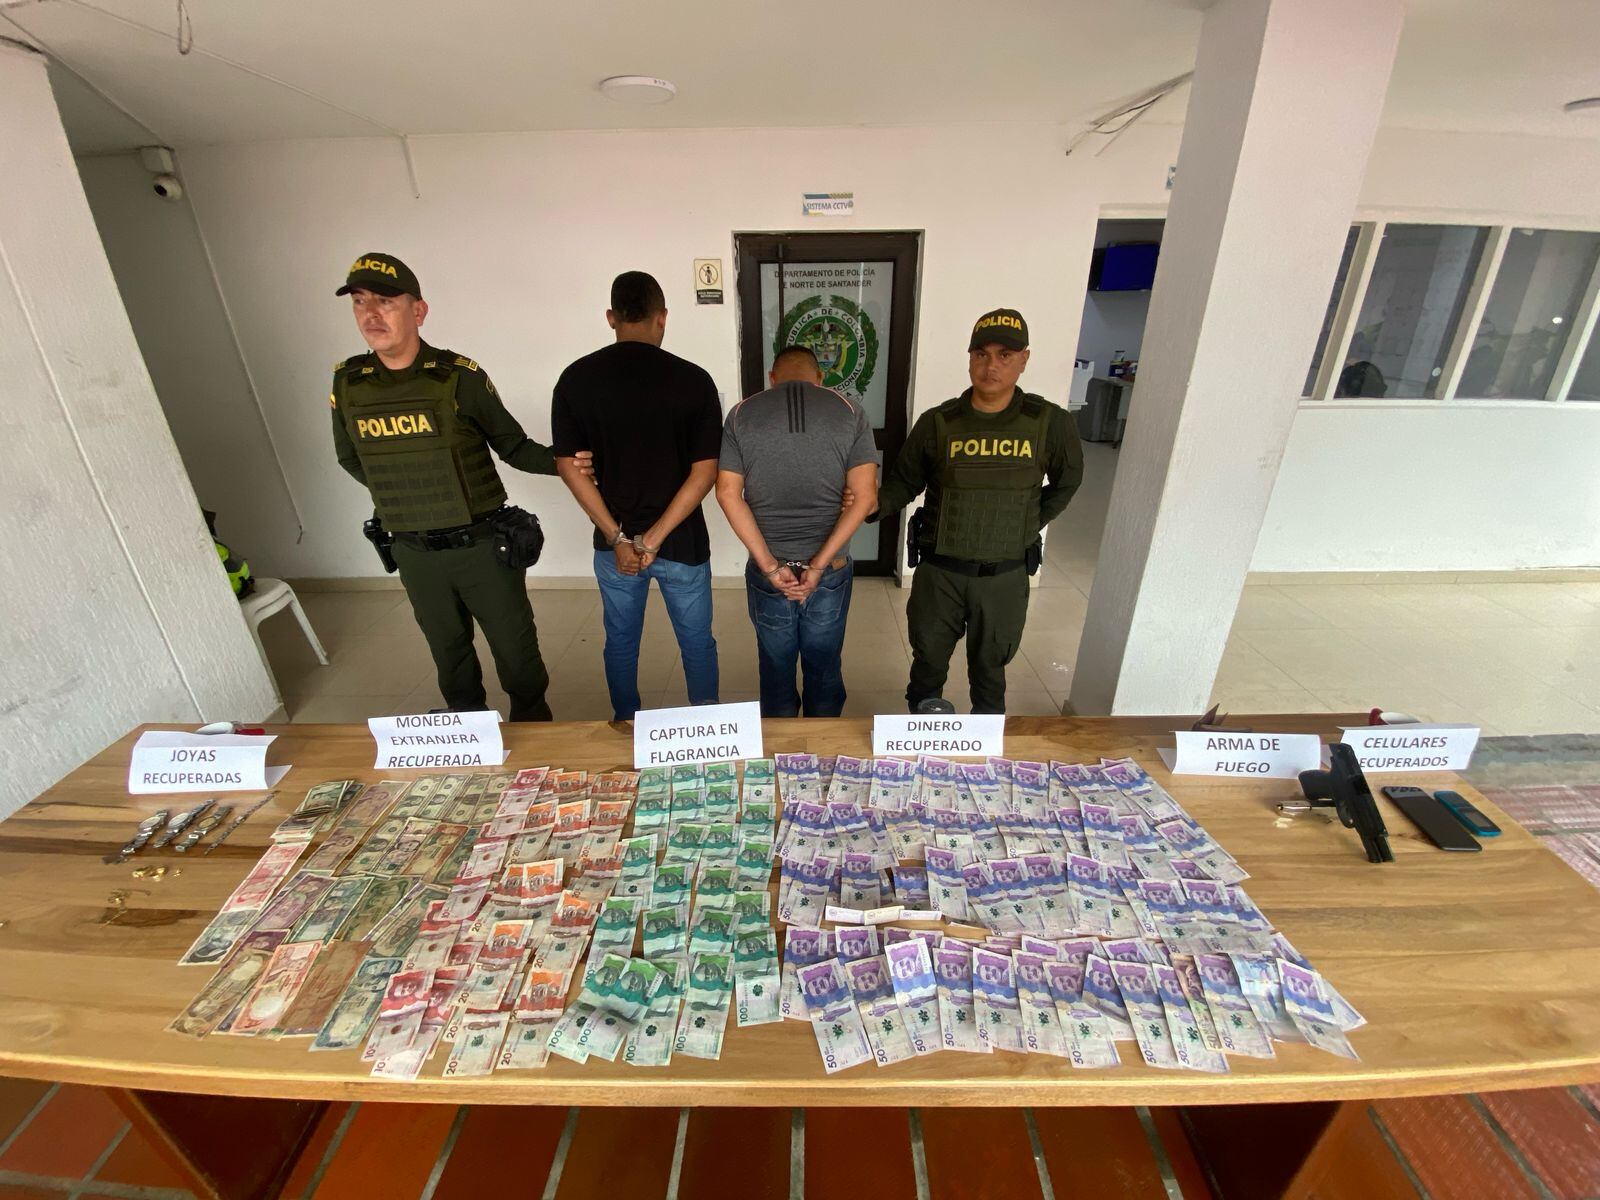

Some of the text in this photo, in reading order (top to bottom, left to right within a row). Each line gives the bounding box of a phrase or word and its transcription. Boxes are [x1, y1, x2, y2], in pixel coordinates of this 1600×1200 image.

[806, 202, 848, 210] SISTEMA CCTV
[834, 269, 845, 277] DE
[789, 281, 815, 289] NORTE
[821, 308, 833, 316] DE
[974, 315, 1022, 332] POLICIA
[833, 367, 862, 392] CIONAL
[357, 414, 433, 438] POLICIA
[950, 438, 1033, 458] POLICIA
[396, 714, 463, 729] MONEDA
[907, 720, 963, 732] DINERO
[649, 722, 739, 742] CAPTURA EN
[390, 733, 480, 746] EXTRANJERA
[886, 739, 983, 752] RECUPERADO
[1206, 737, 1281, 751] ARMA DE
[1363, 736, 1448, 749] CELULARES
[170, 749, 217, 763] JOYAS
[388, 753, 482, 768] RECUPERADA
[650, 744, 740, 764] FLAGRANCIA
[1214, 760, 1271, 774] FUEGO
[1359, 756, 1449, 768] ECUPERADOS
[143, 771, 242, 785] RECUPERADAS
